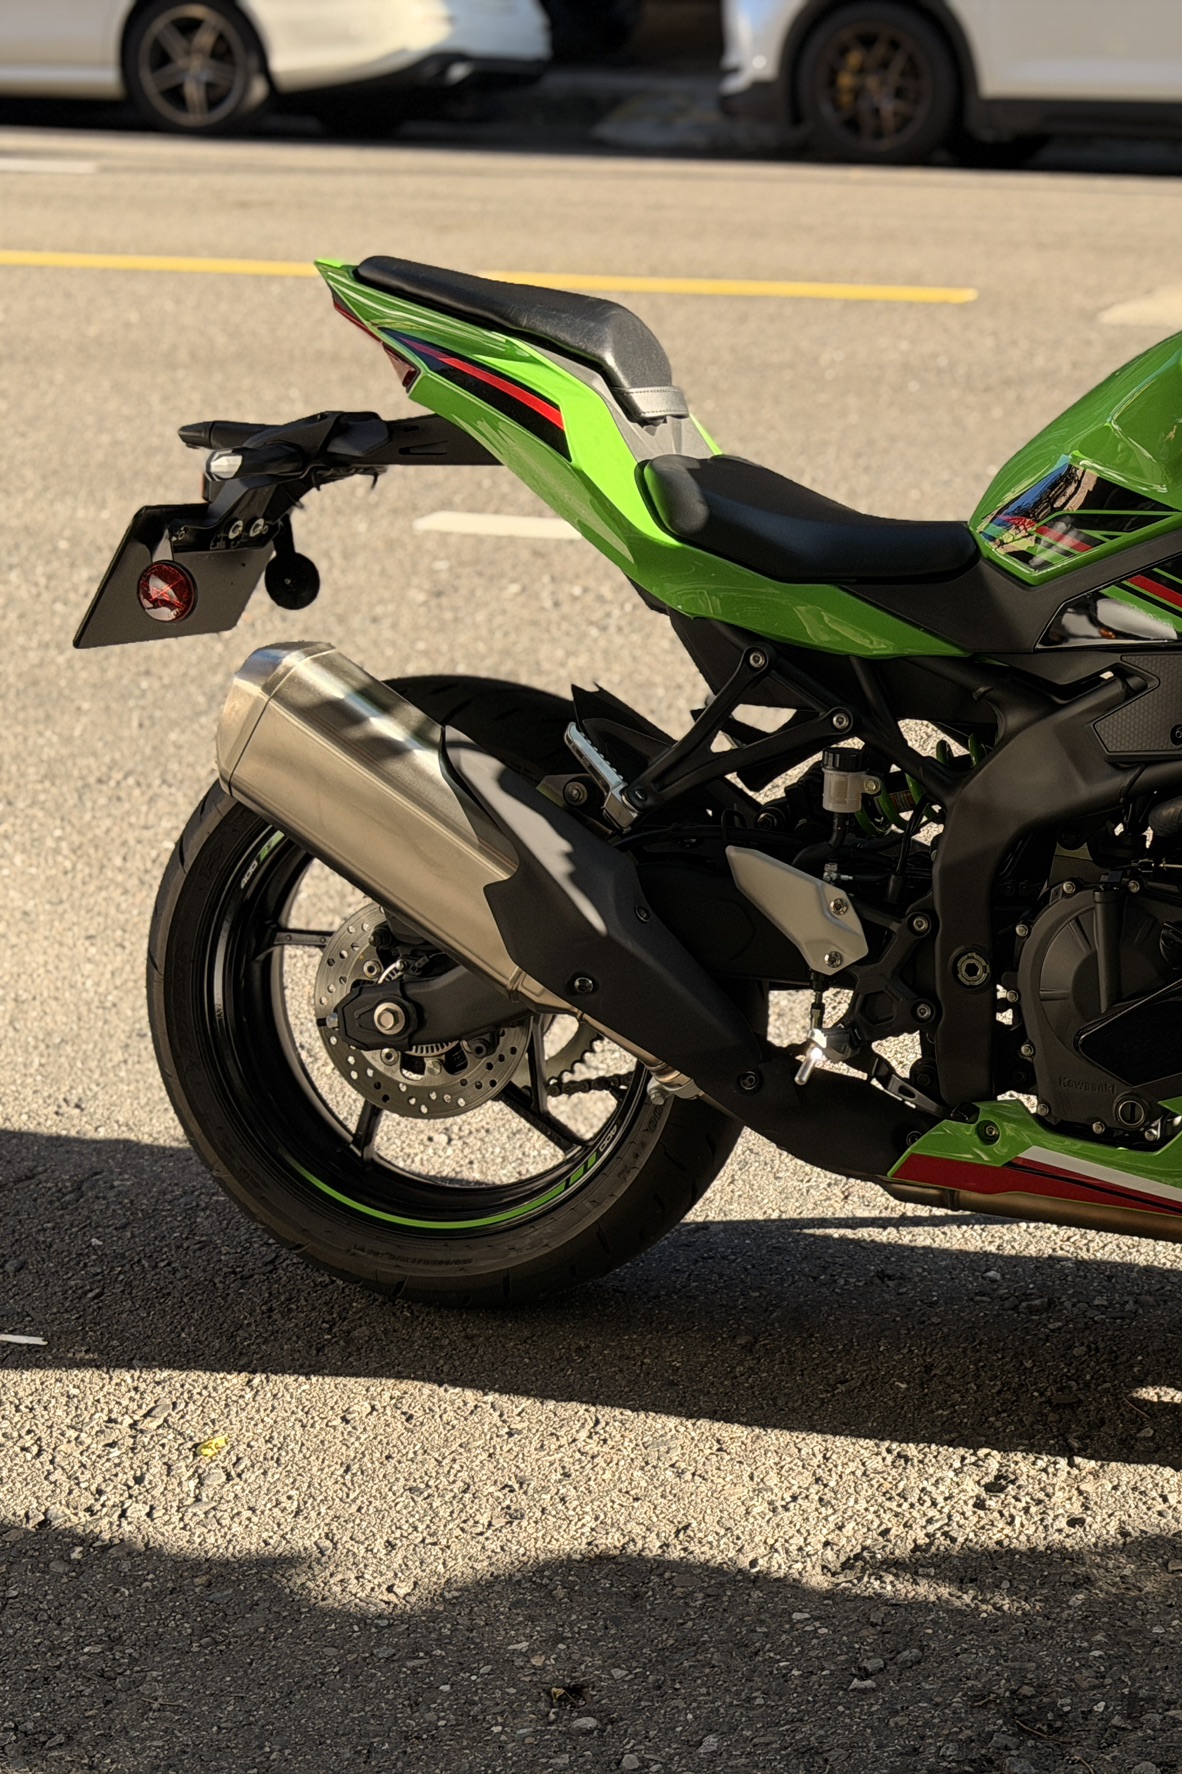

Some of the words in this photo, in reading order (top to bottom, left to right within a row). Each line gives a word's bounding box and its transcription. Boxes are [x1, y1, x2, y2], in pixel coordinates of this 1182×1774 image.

[241, 859, 258, 889] 400
[1058, 1076, 1117, 1095] Kawasaki
[599, 1124, 618, 1152] 400
